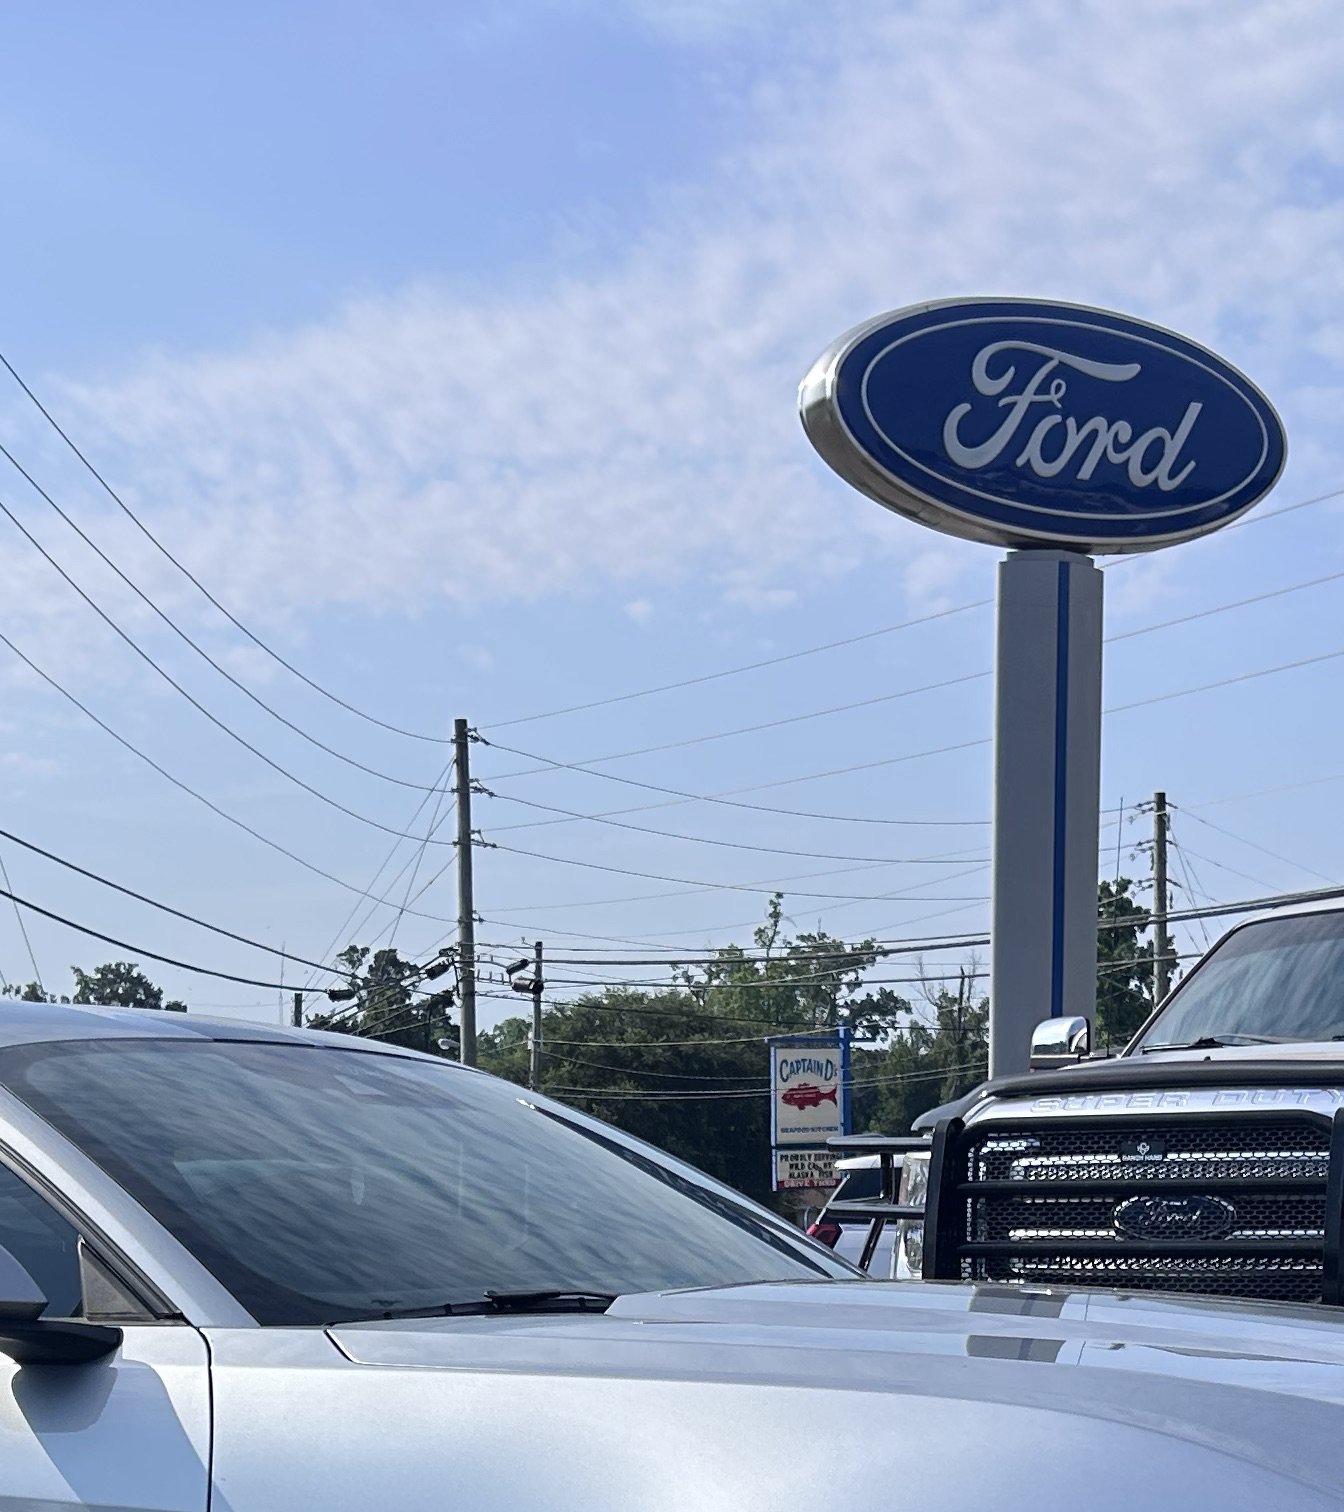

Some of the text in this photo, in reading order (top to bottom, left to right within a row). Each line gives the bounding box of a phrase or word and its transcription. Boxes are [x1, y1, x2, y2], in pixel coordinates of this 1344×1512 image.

[943, 340, 1201, 492] Ford
[780, 1058, 823, 1082] CAPTAIN
[1030, 1091, 1191, 1113] SUPER
[1139, 1200, 1201, 1227] Ford
